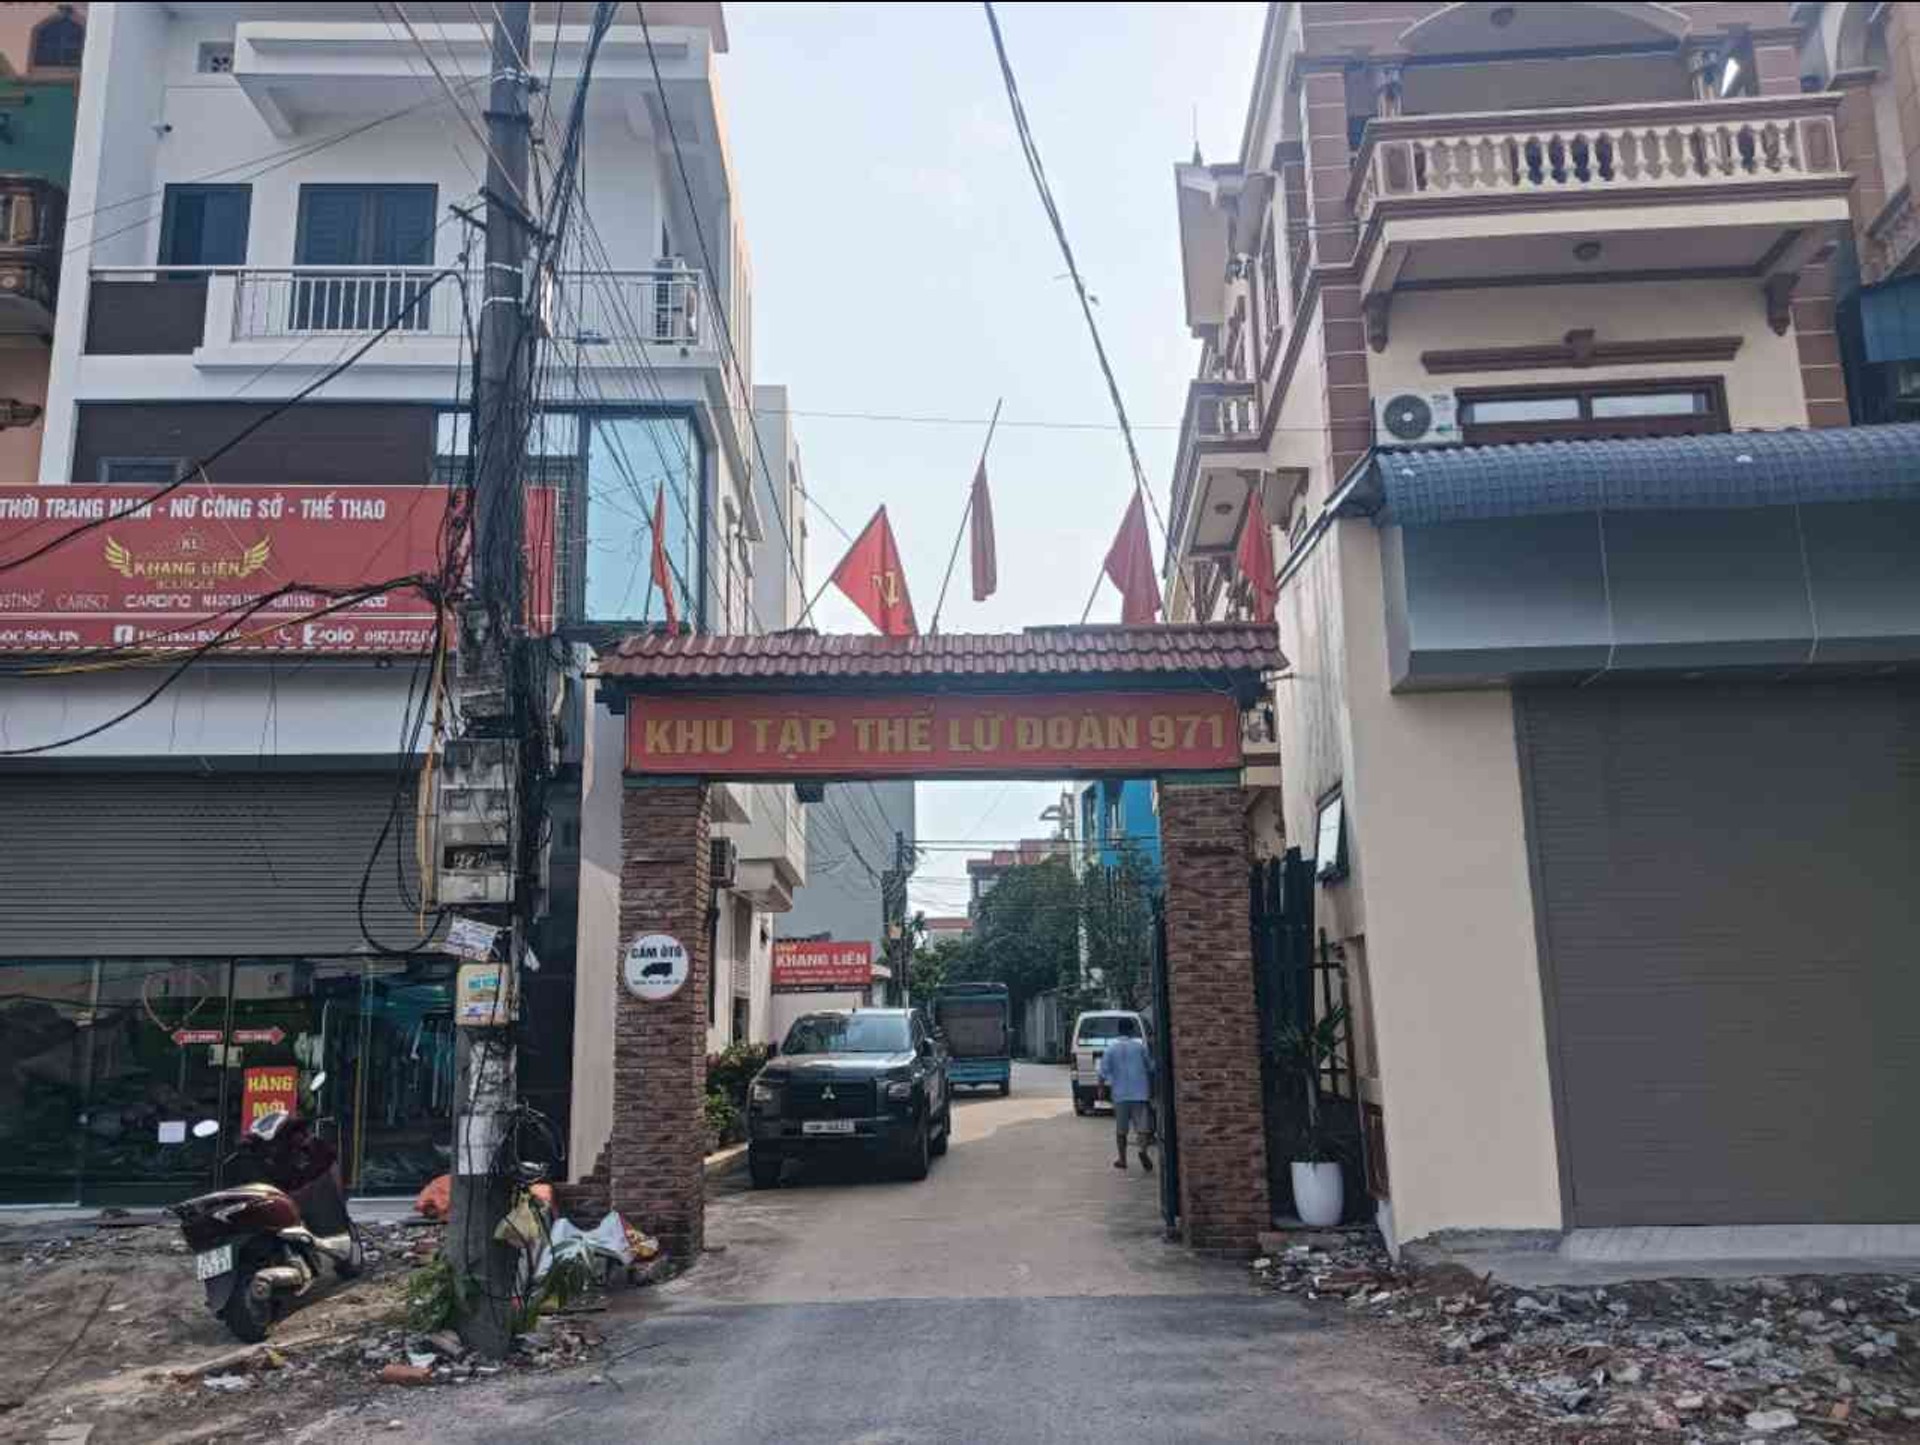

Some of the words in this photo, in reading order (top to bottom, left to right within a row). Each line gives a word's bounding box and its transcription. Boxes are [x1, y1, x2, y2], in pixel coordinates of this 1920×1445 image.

[0, 494, 40, 518] THỜI
[45, 498, 104, 518] TRANG
[108, 498, 152, 519] NAM
[170, 493, 200, 518] NỮ
[202, 493, 252, 518] CÔNG
[258, 492, 285, 518] SỞ
[340, 498, 385, 519] THAO
[133, 561, 196, 576] KHANG
[646, 718, 733, 754] KHU
[752, 711, 836, 760] TẬP
[949, 710, 1012, 751] LỮ
[1014, 707, 1140, 750] ĐOÀN
[1151, 713, 1225, 750] 971
[775, 953, 829, 968] KHANG
[247, 1073, 293, 1092] HÀNG
